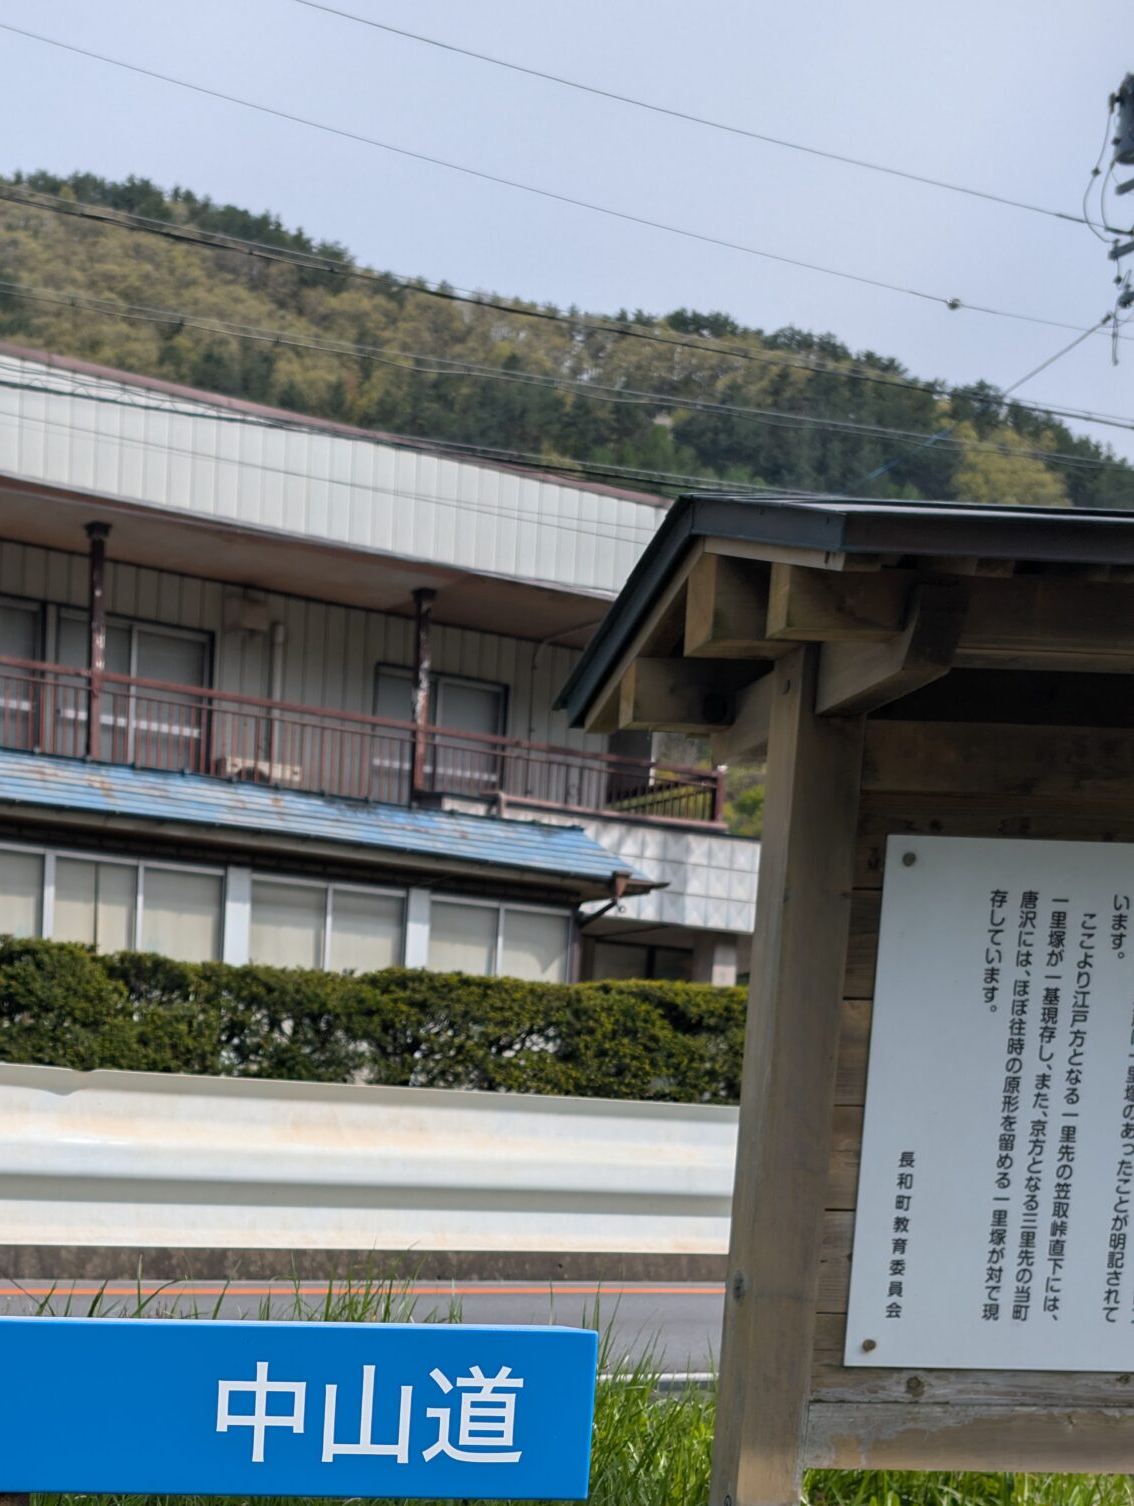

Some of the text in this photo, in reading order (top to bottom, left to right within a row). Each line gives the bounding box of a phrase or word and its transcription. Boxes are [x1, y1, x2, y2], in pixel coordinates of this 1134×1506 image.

[981, 889, 1009, 1013] 存しています。
[1110, 894, 1131, 960] います。
[981, 890, 1040, 1321] 唐沢には、ほぼ往時の原形を留める一里塚が対で現
[1012, 897, 1070, 1321] 一里塚が一基現存し、また、京方となる三里先の当町
[1043, 913, 1098, 1321] ここより江戸方となる一里先の笠取峠直下には、
[885, 1150, 916, 1320] 長和町教育委員会
[215, 1361, 525, 1464] 中山道
